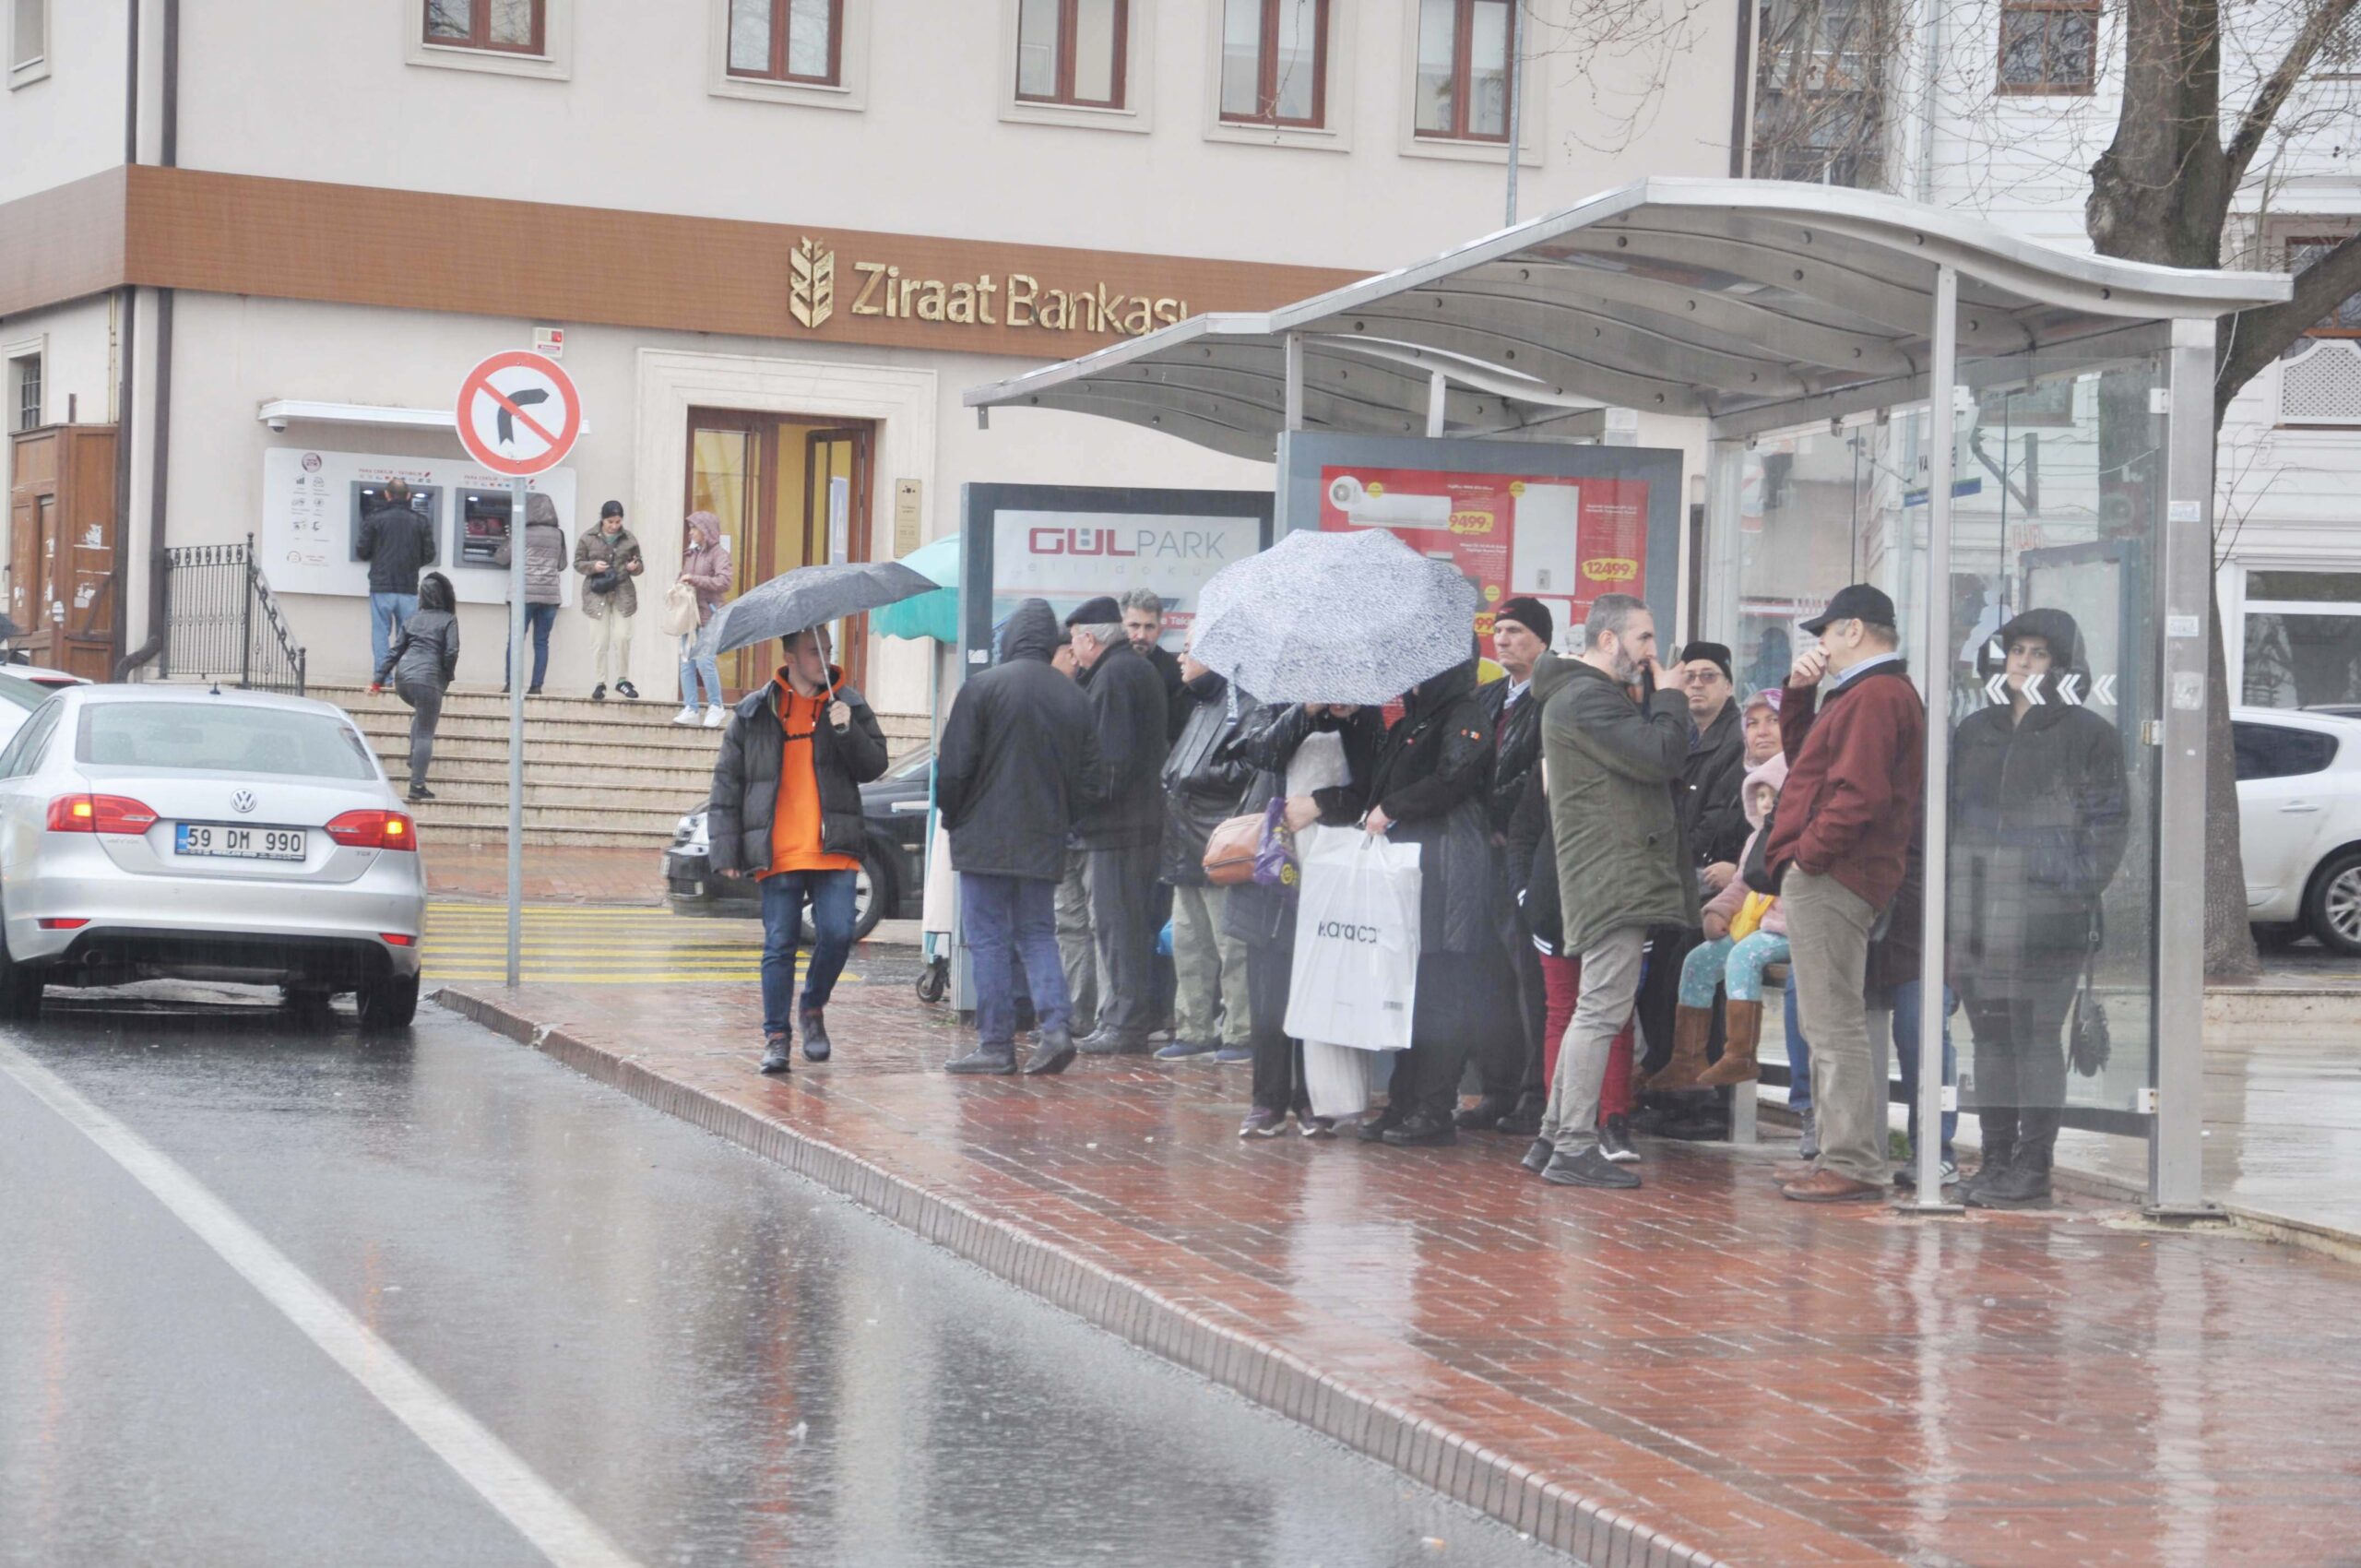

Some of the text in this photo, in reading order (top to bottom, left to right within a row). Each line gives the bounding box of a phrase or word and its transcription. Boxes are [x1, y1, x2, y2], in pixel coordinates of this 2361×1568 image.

[851, 261, 1189, 337] Ziraat Bankası
[187, 827, 302, 852] 59 DM 990
